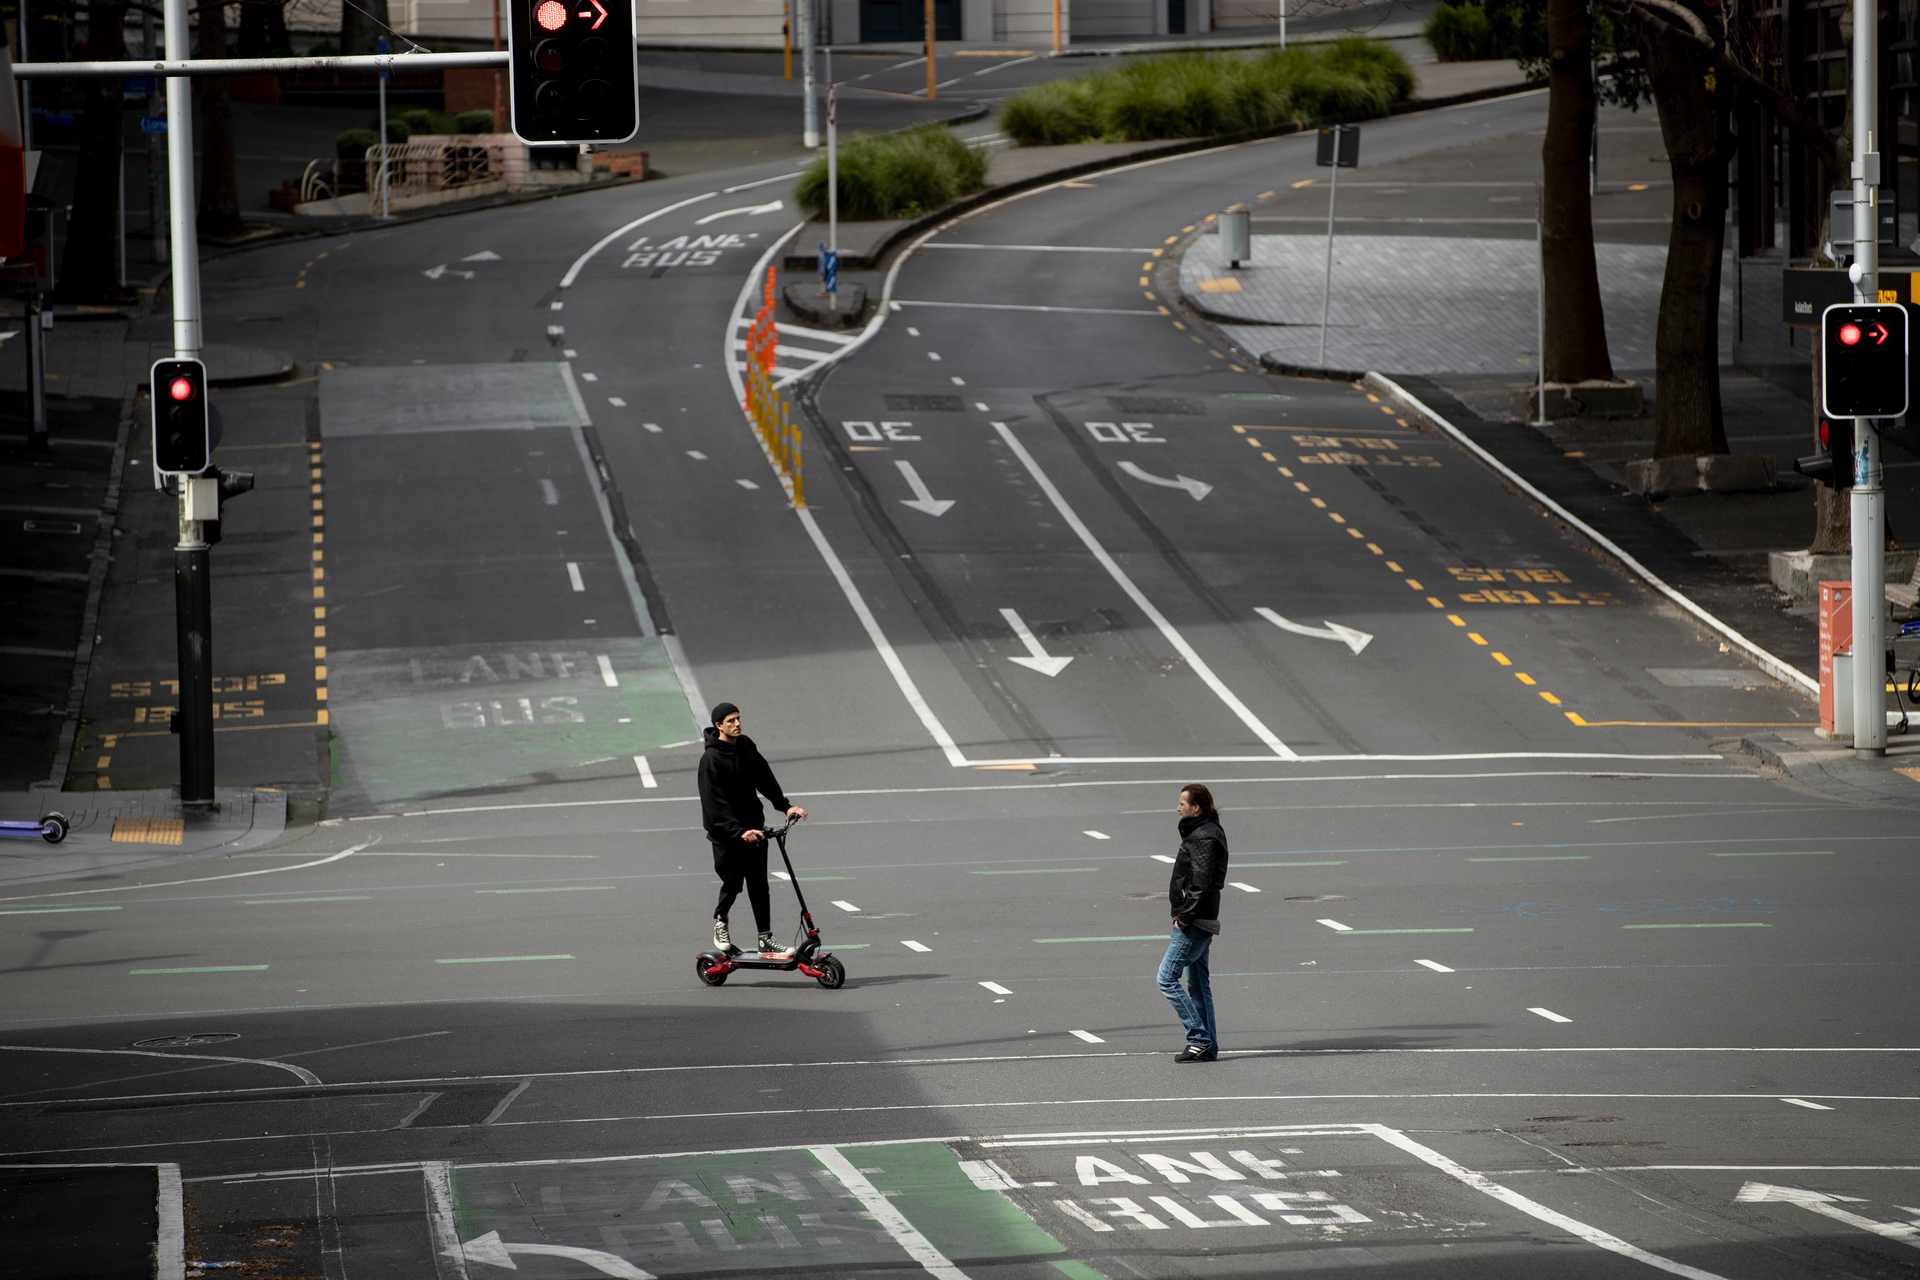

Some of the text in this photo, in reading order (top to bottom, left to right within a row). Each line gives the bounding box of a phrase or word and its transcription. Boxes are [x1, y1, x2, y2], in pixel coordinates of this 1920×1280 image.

[626, 233, 759, 251] LANE
[621, 250, 723, 269] BUS
[1291, 434, 1400, 451] BUS
[1298, 450, 1443, 468] STOP
[1446, 567, 1572, 584] BUS
[1457, 589, 1625, 606] STOP
[134, 700, 265, 724] BS
[439, 696, 586, 730] BUS
[1053, 1190, 1374, 1233] BUS
